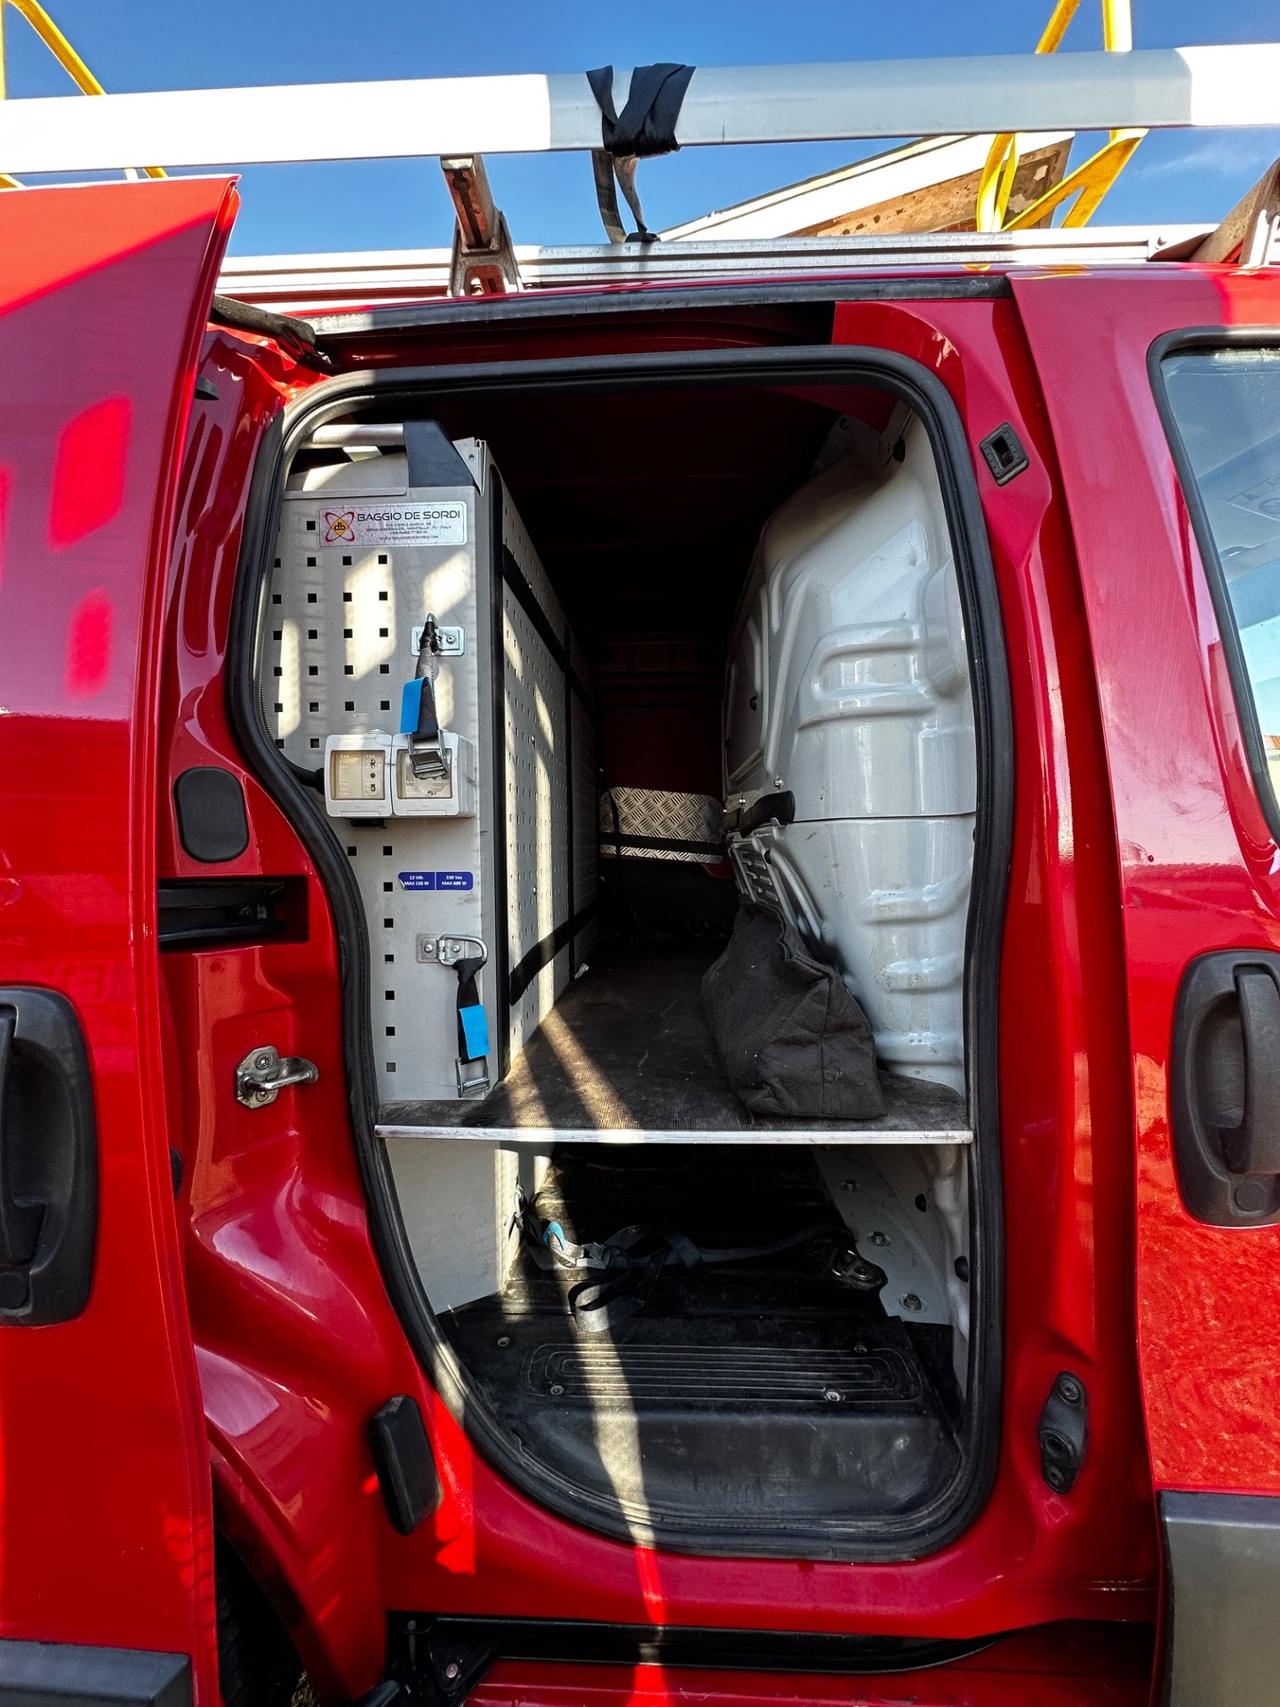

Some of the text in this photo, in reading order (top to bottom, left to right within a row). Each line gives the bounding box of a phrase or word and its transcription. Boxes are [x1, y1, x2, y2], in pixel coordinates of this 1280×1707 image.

[357, 510, 460, 522] BAGGIO DE SORDI
